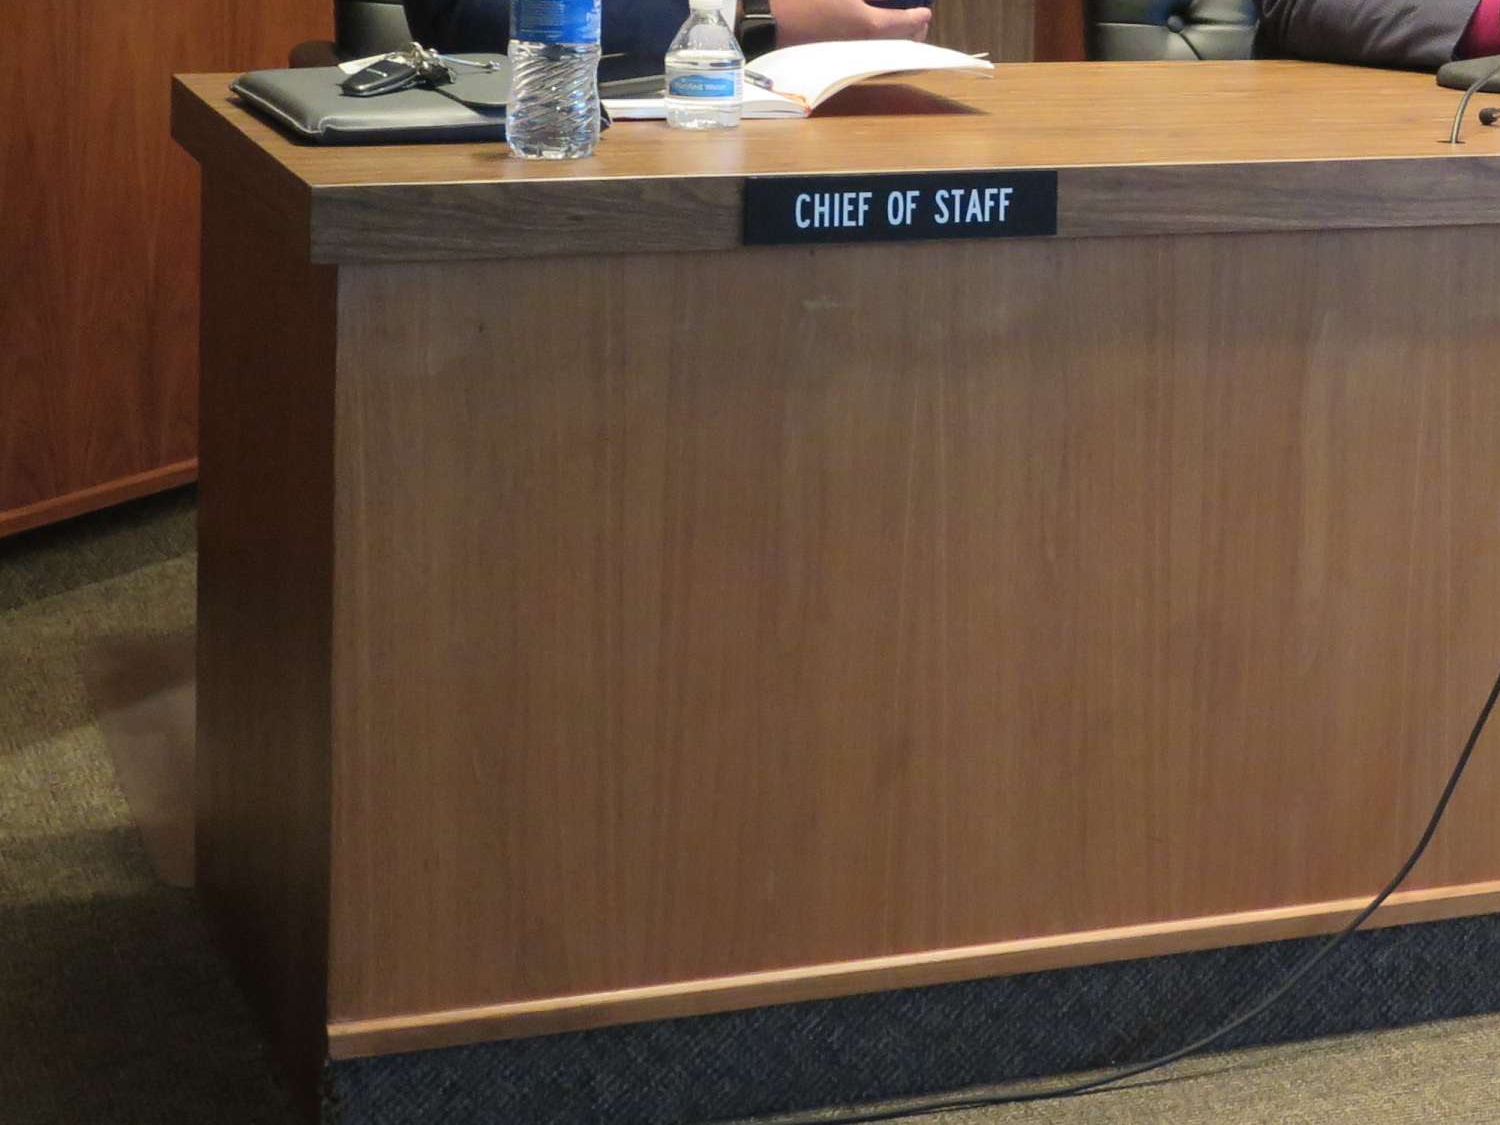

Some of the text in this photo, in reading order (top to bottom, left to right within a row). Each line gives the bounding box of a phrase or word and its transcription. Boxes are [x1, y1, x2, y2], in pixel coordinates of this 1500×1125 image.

[795, 187, 1014, 229] CHIEF OF STAFF
